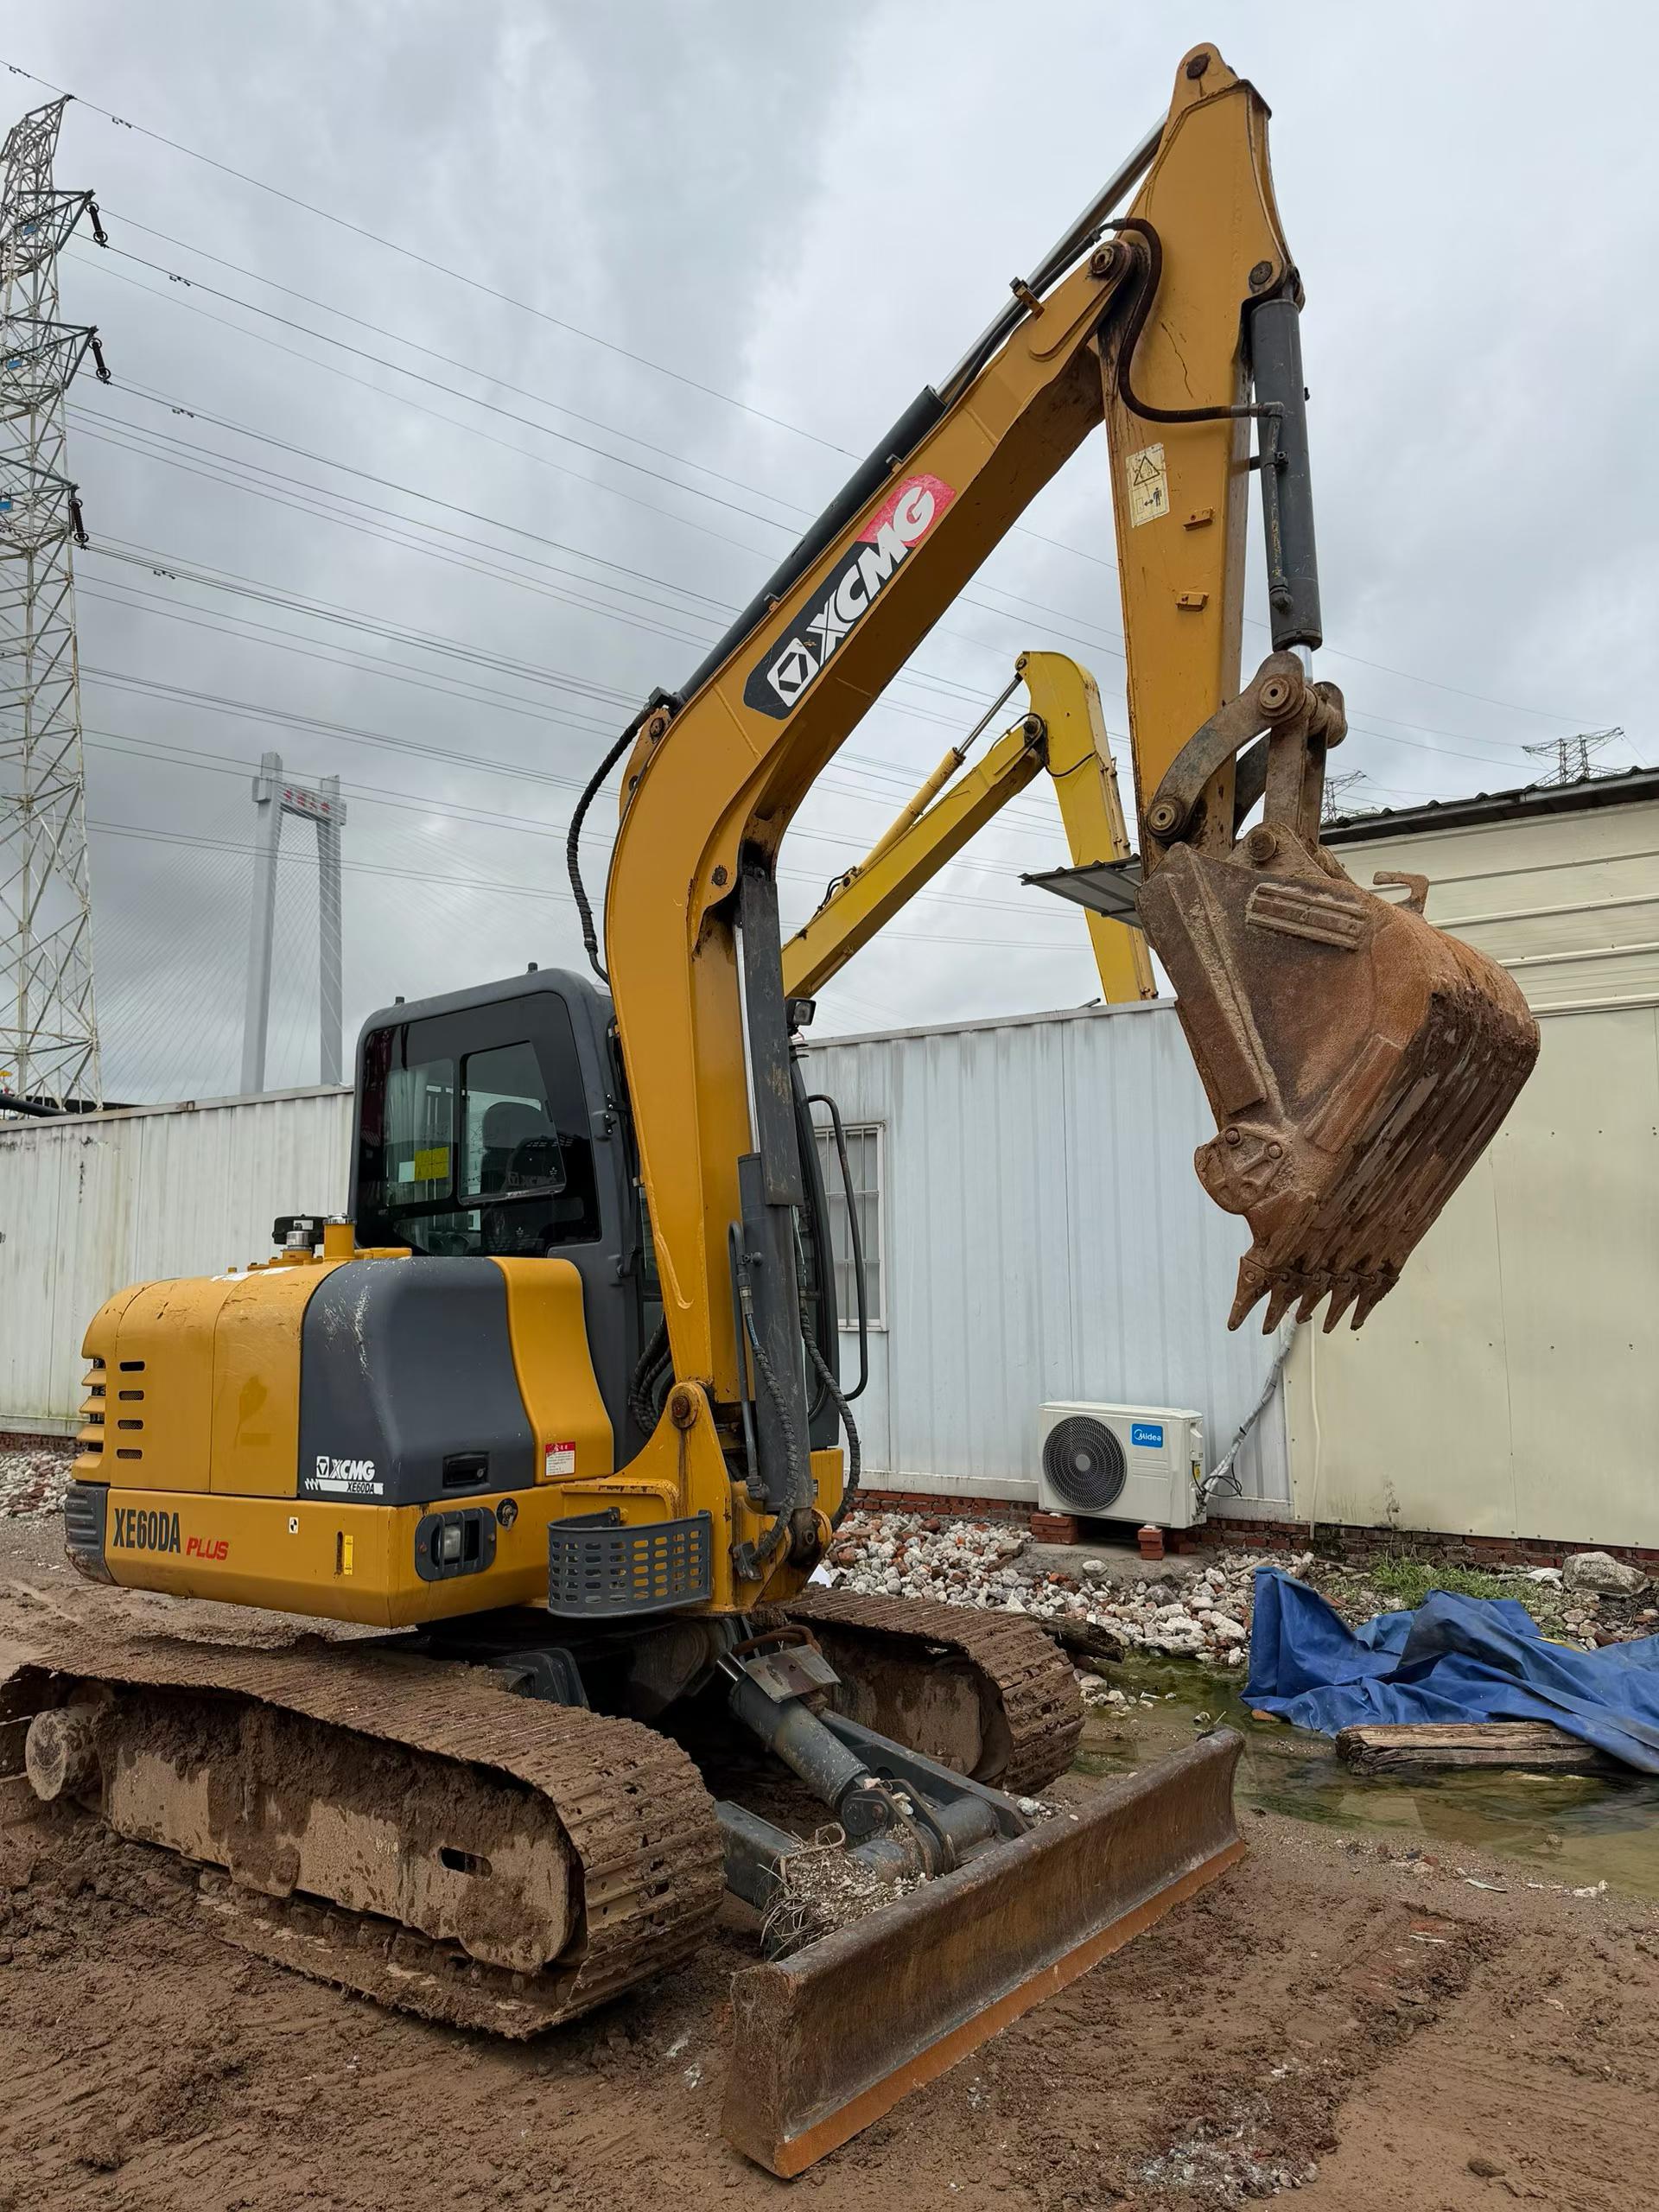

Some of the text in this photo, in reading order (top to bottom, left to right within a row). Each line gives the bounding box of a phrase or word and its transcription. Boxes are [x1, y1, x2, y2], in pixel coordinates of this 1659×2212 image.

[806, 486, 935, 667] XCMG
[1134, 1428, 1161, 1441] Midea
[329, 1459, 375, 1481] XCMG
[346, 1482, 374, 1493] XE60DA
[113, 1508, 229, 1560] XE60DA PLUS
